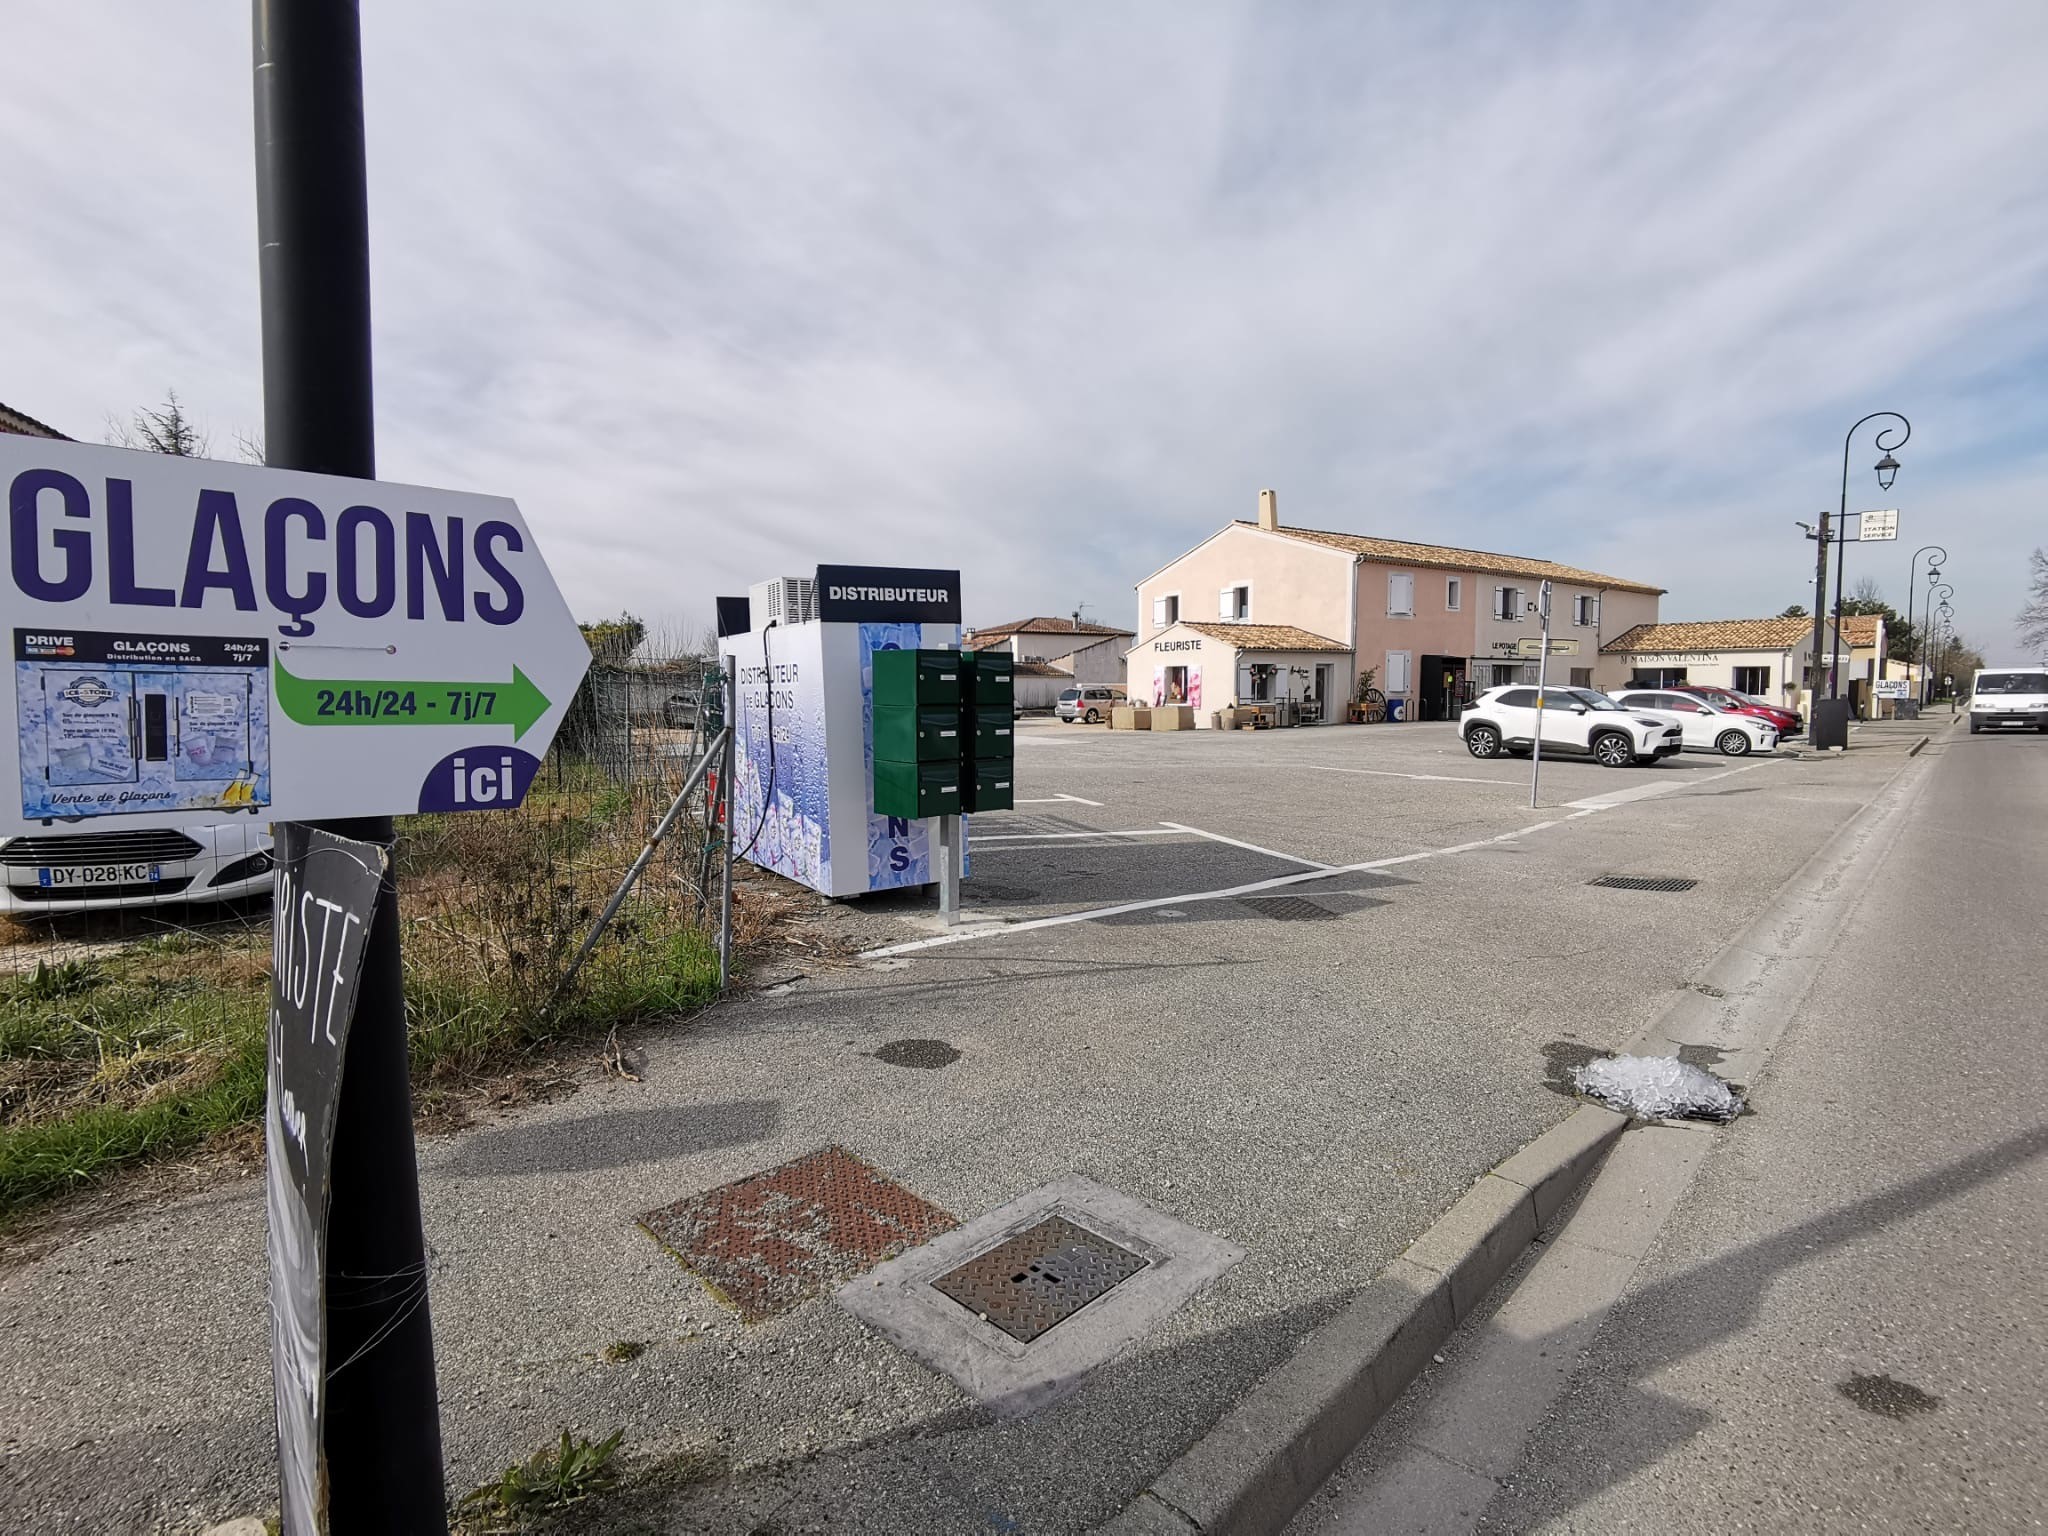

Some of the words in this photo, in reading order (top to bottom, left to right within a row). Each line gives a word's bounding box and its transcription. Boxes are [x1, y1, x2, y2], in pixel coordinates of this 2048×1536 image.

[9, 468, 525, 637] GLAÇONS
[829, 586, 948, 602] DISTRIBUTEUR
[25, 635, 74, 646] DRIVE
[1154, 640, 1202, 652] FLEURISTE
[113, 641, 190, 654] GLAÇONS
[223, 643, 260, 652] 24h/24
[106, 653, 162, 661] Distribution
[1631, 655, 1665, 663] MAISON
[1667, 654, 1719, 662] VALENTINA
[317, 690, 417, 718] 24h/24
[447, 692, 497, 720] 7j/7
[453, 756, 513, 803] ici
[51, 793, 94, 804] Vente
[96, 793, 116, 802] de
[118, 791, 171, 804] Glaçons
[53, 865, 146, 883] DY-028-KC
